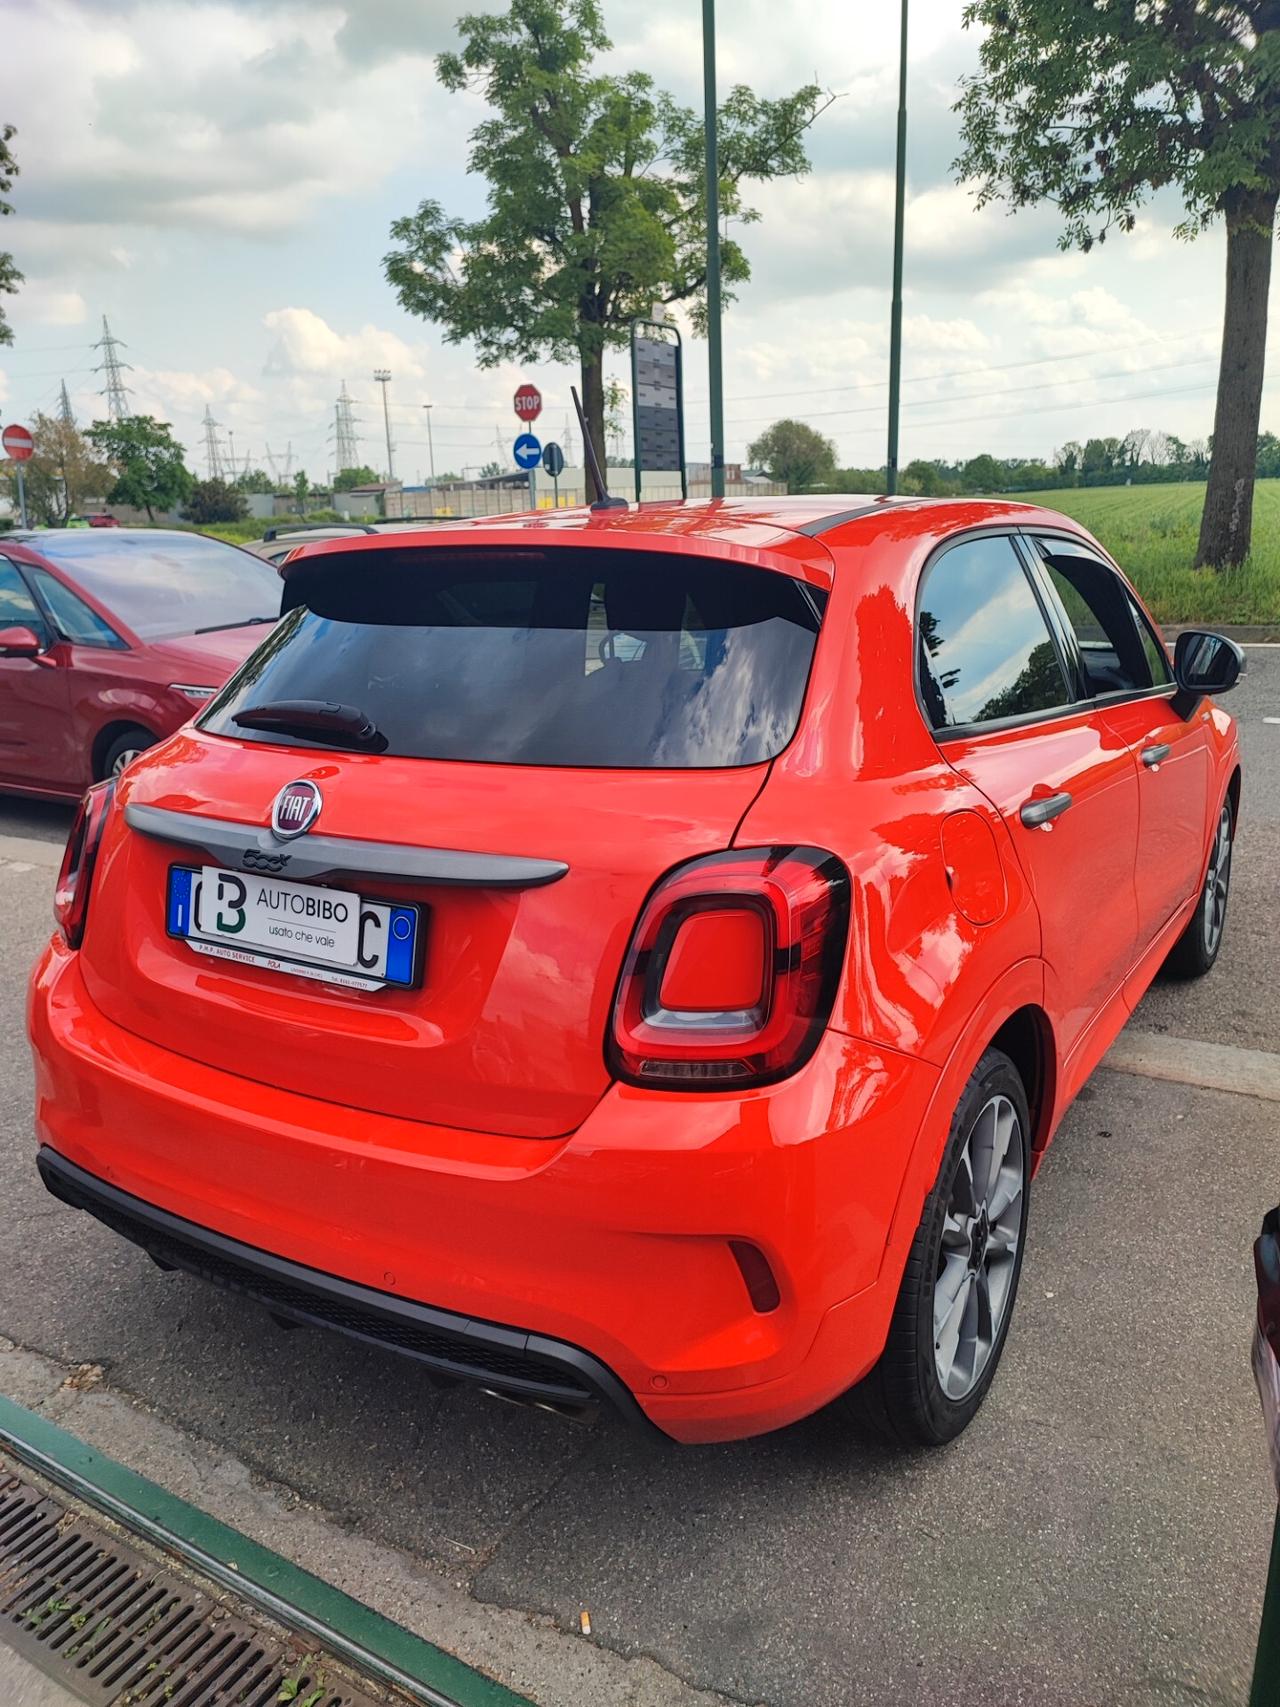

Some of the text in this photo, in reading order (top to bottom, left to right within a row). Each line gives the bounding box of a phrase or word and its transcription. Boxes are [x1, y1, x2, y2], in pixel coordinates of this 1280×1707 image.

[515, 395, 540, 411] STOP
[279, 796, 311, 821] FIAT
[257, 888, 348, 922] AUTOBIBO
[268, 925, 336, 948] usato che vale
